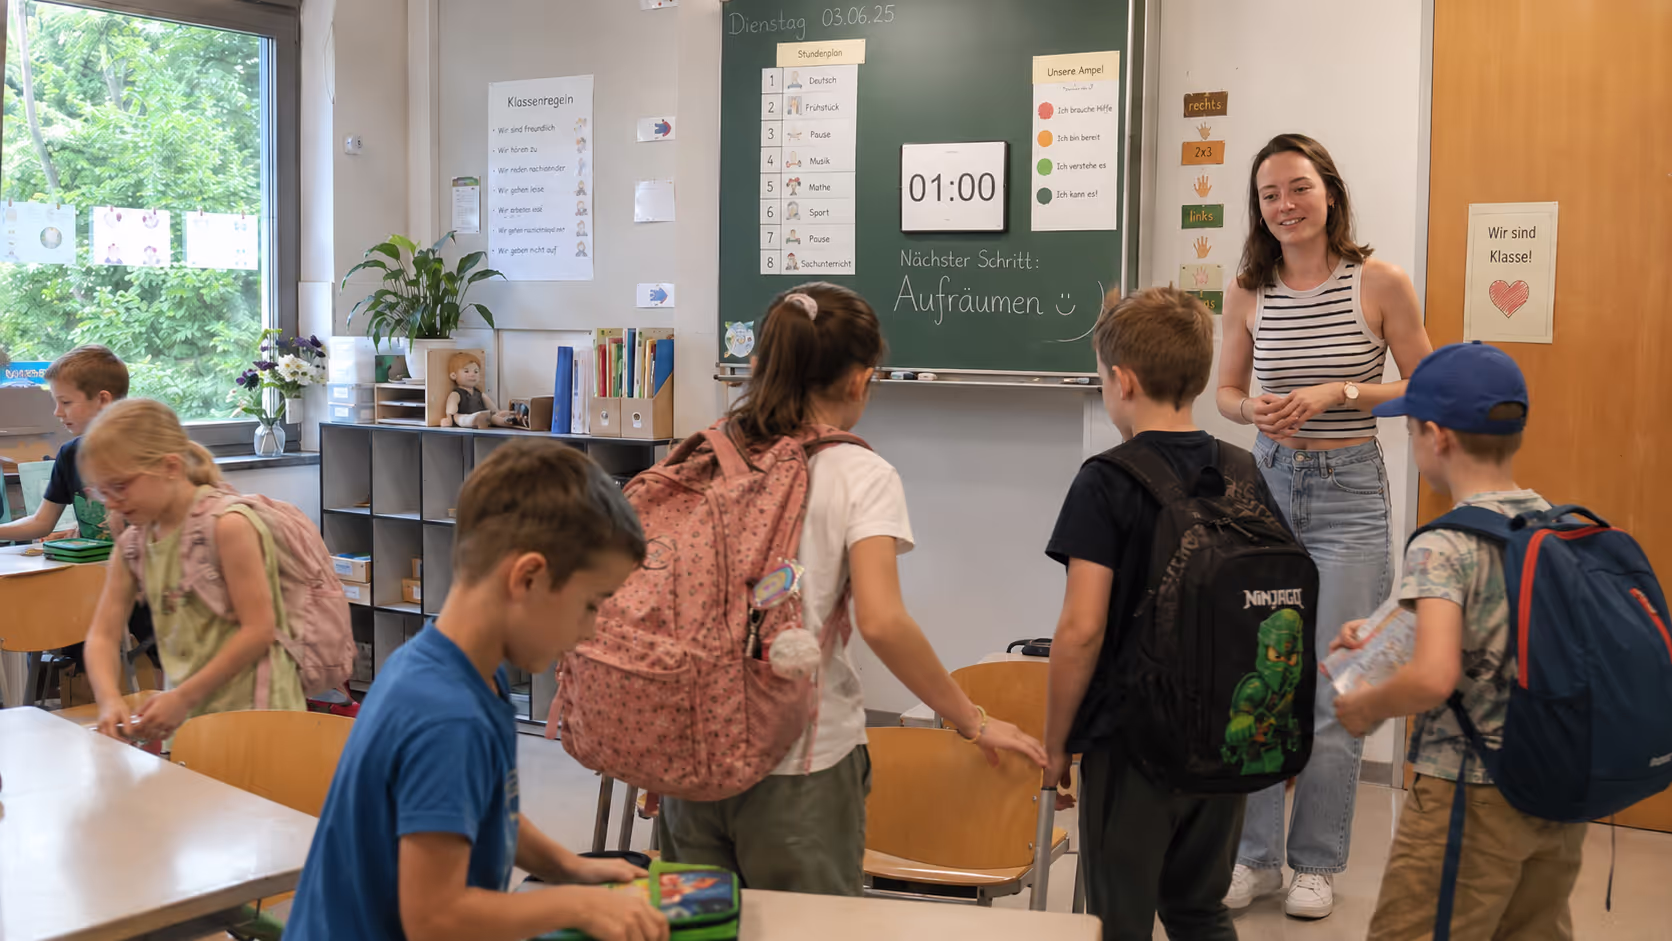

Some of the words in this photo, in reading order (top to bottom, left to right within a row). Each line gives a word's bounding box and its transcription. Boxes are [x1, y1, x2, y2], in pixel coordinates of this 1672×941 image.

[728, 9, 806, 41] Dienstag
[822, 4, 896, 27] 03.06.25
[797, 48, 843, 60] Stundenplan
[1047, 67, 1076, 77] Unsere
[1078, 64, 1104, 77] Ampel
[769, 75, 775, 87] 1
[809, 76, 837, 85] Deutsch
[507, 93, 574, 109] Klassenregeln
[767, 101, 775, 113] 2
[805, 102, 840, 112] Frühstück
[1188, 98, 1222, 111] rechts
[1057, 106, 1069, 114] Ich
[1070, 105, 1095, 114] brauche
[497, 126, 509, 135] Wir
[767, 128, 775, 140] 3
[810, 130, 832, 139] Pause
[1057, 134, 1069, 142] Ich
[1070, 132, 1080, 142] bin
[1080, 134, 1101, 142] bereit
[1195, 146, 1213, 158] 2x3
[766, 154, 774, 167] 4
[809, 157, 831, 165] Musik
[1056, 162, 1068, 171] Ich
[1069, 161, 1097, 170] verstehe
[766, 180, 774, 193] 5
[808, 183, 831, 192] Mathe
[908, 172, 997, 202] 01:00
[1056, 190, 1068, 199] Ich
[1069, 189, 1085, 198] kann
[1087, 189, 1098, 198] es!
[766, 206, 774, 218] 6
[809, 208, 830, 219] Sport
[1189, 209, 1214, 223] links
[766, 231, 774, 244] 7
[809, 234, 830, 243] Pause
[1488, 226, 1508, 239] Wir
[1511, 225, 1536, 239] sind
[766, 256, 774, 269] 8
[900, 249, 970, 268] Nächster
[977, 249, 1040, 270] Schritt:
[1489, 249, 1533, 264] Klasse!
[893, 274, 1045, 326] Aufräumen
[1242, 587, 1306, 610] NINJAGO
